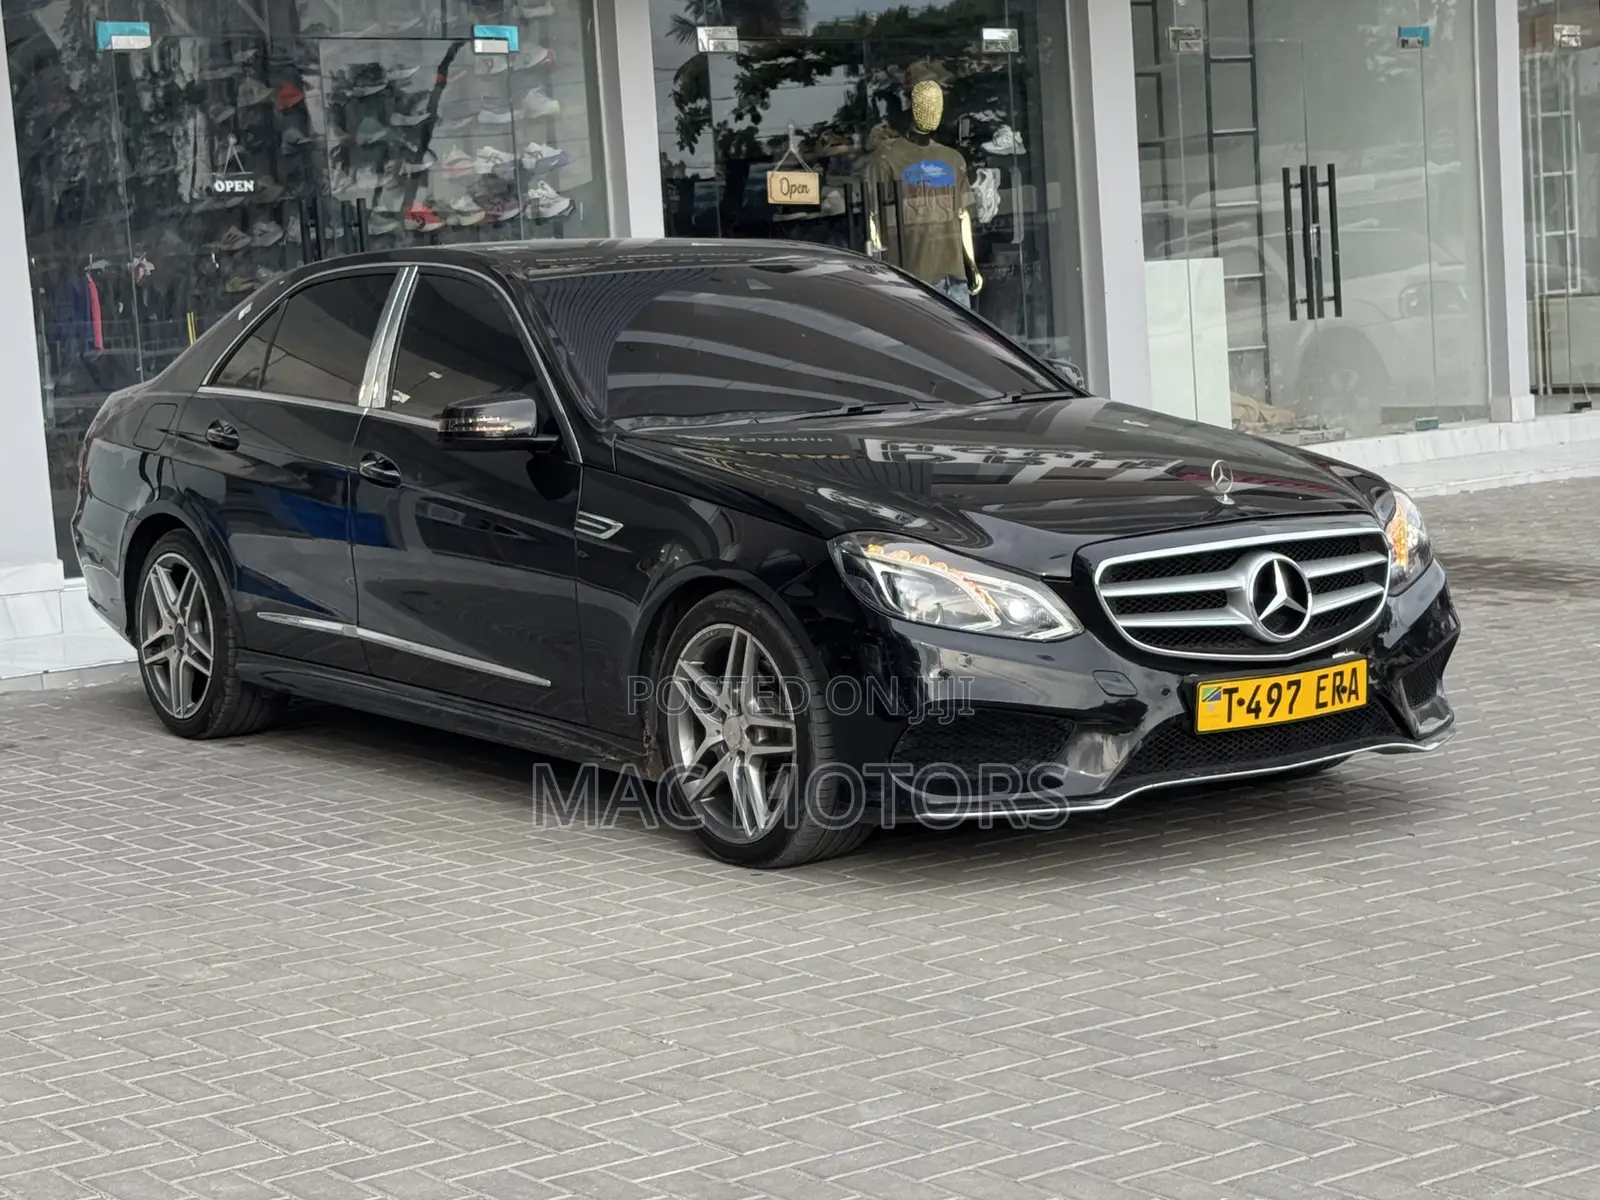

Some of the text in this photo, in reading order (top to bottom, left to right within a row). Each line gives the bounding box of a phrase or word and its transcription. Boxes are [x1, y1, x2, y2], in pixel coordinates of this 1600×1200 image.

[214, 180, 254, 192] OPEN
[779, 177, 811, 199] Open
[1315, 667, 1360, 710] ERA
